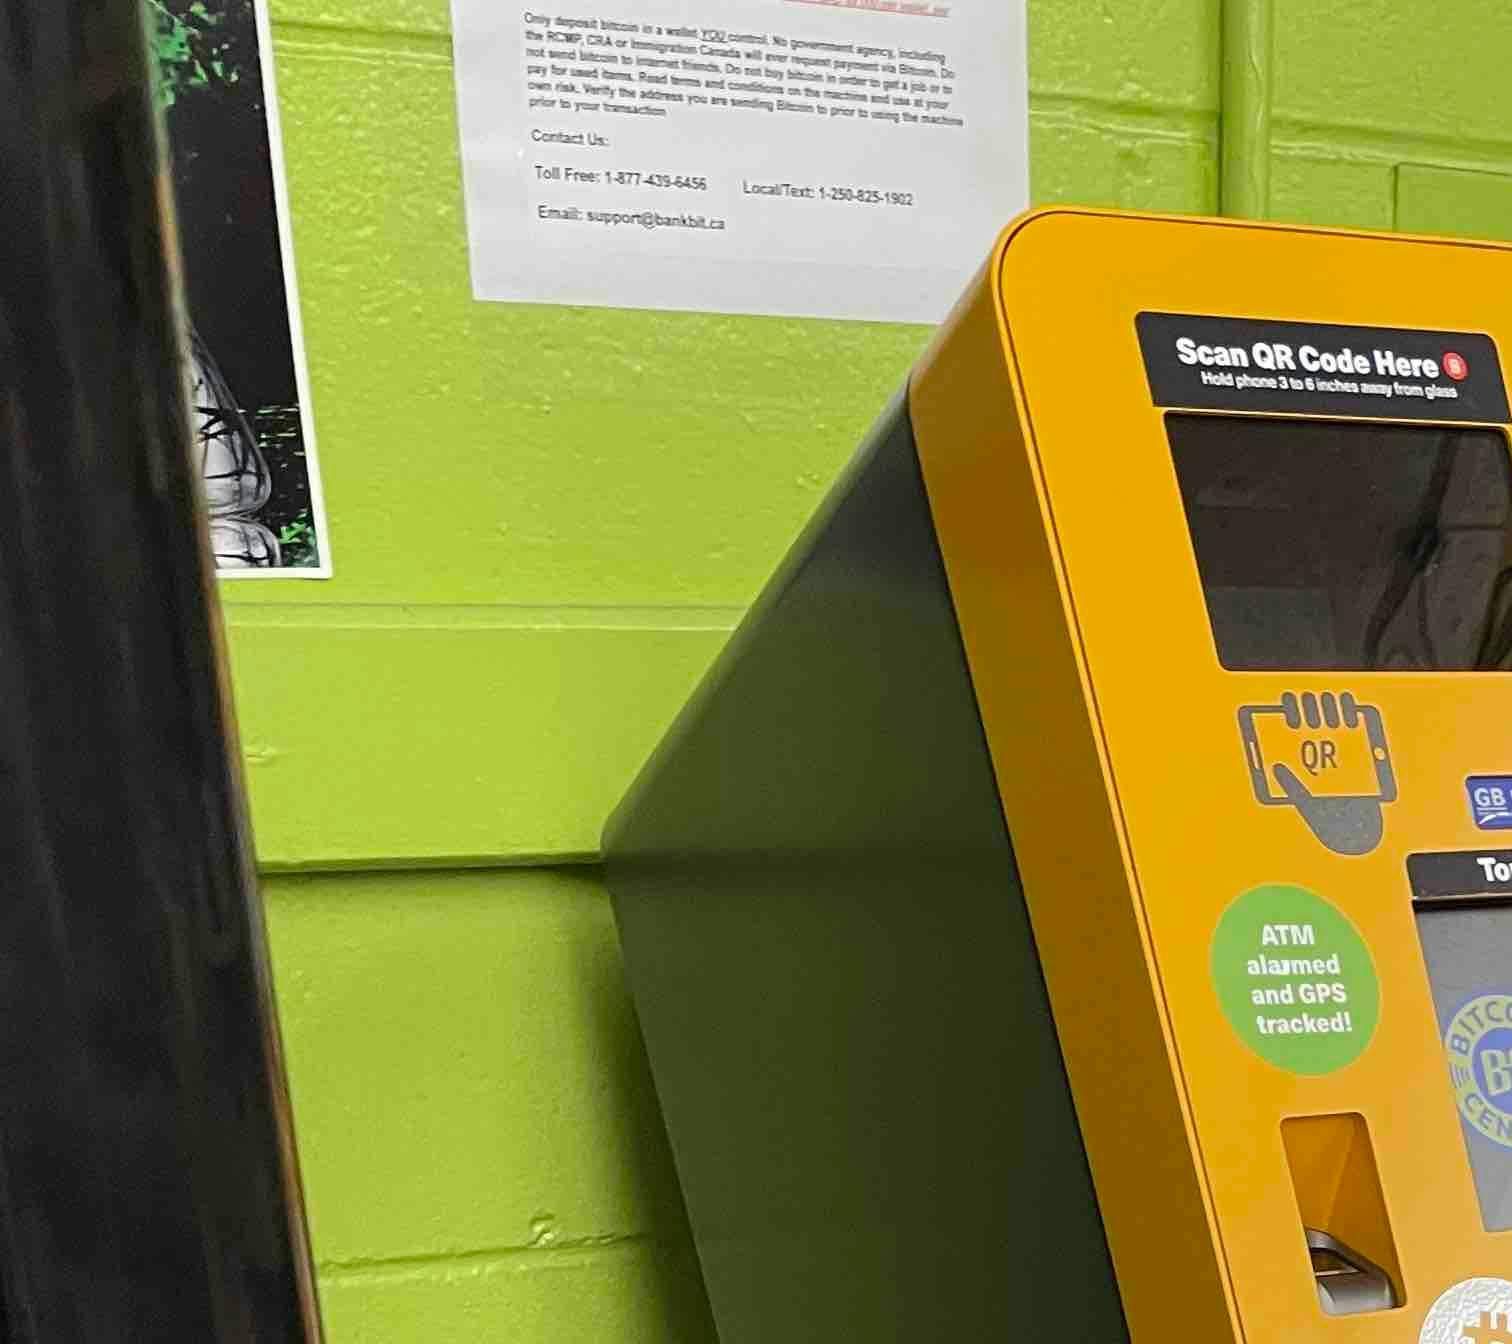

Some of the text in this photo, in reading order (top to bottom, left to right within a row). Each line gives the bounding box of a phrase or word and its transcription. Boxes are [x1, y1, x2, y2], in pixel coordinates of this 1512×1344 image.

[531, 128, 611, 148] Contact Us:
[535, 165, 562, 181] Toll
[564, 166, 601, 183] Free:
[538, 204, 726, 231] Email: support@bankbit.ca
[1175, 337, 1250, 369] Scan
[1252, 341, 1297, 371] QR
[1299, 345, 1372, 375] Code
[1373, 349, 1441, 379] Here
[1200, 370, 1460, 401] Hold phone 3 to 6 inches away from glass
[1301, 740, 1338, 772] QR
[1474, 786, 1507, 809] GB
[1261, 924, 1316, 947] ATM
[1247, 953, 1342, 976] alarmed
[1251, 982, 1348, 1006] and GPS
[1256, 1011, 1353, 1035] tracked!
